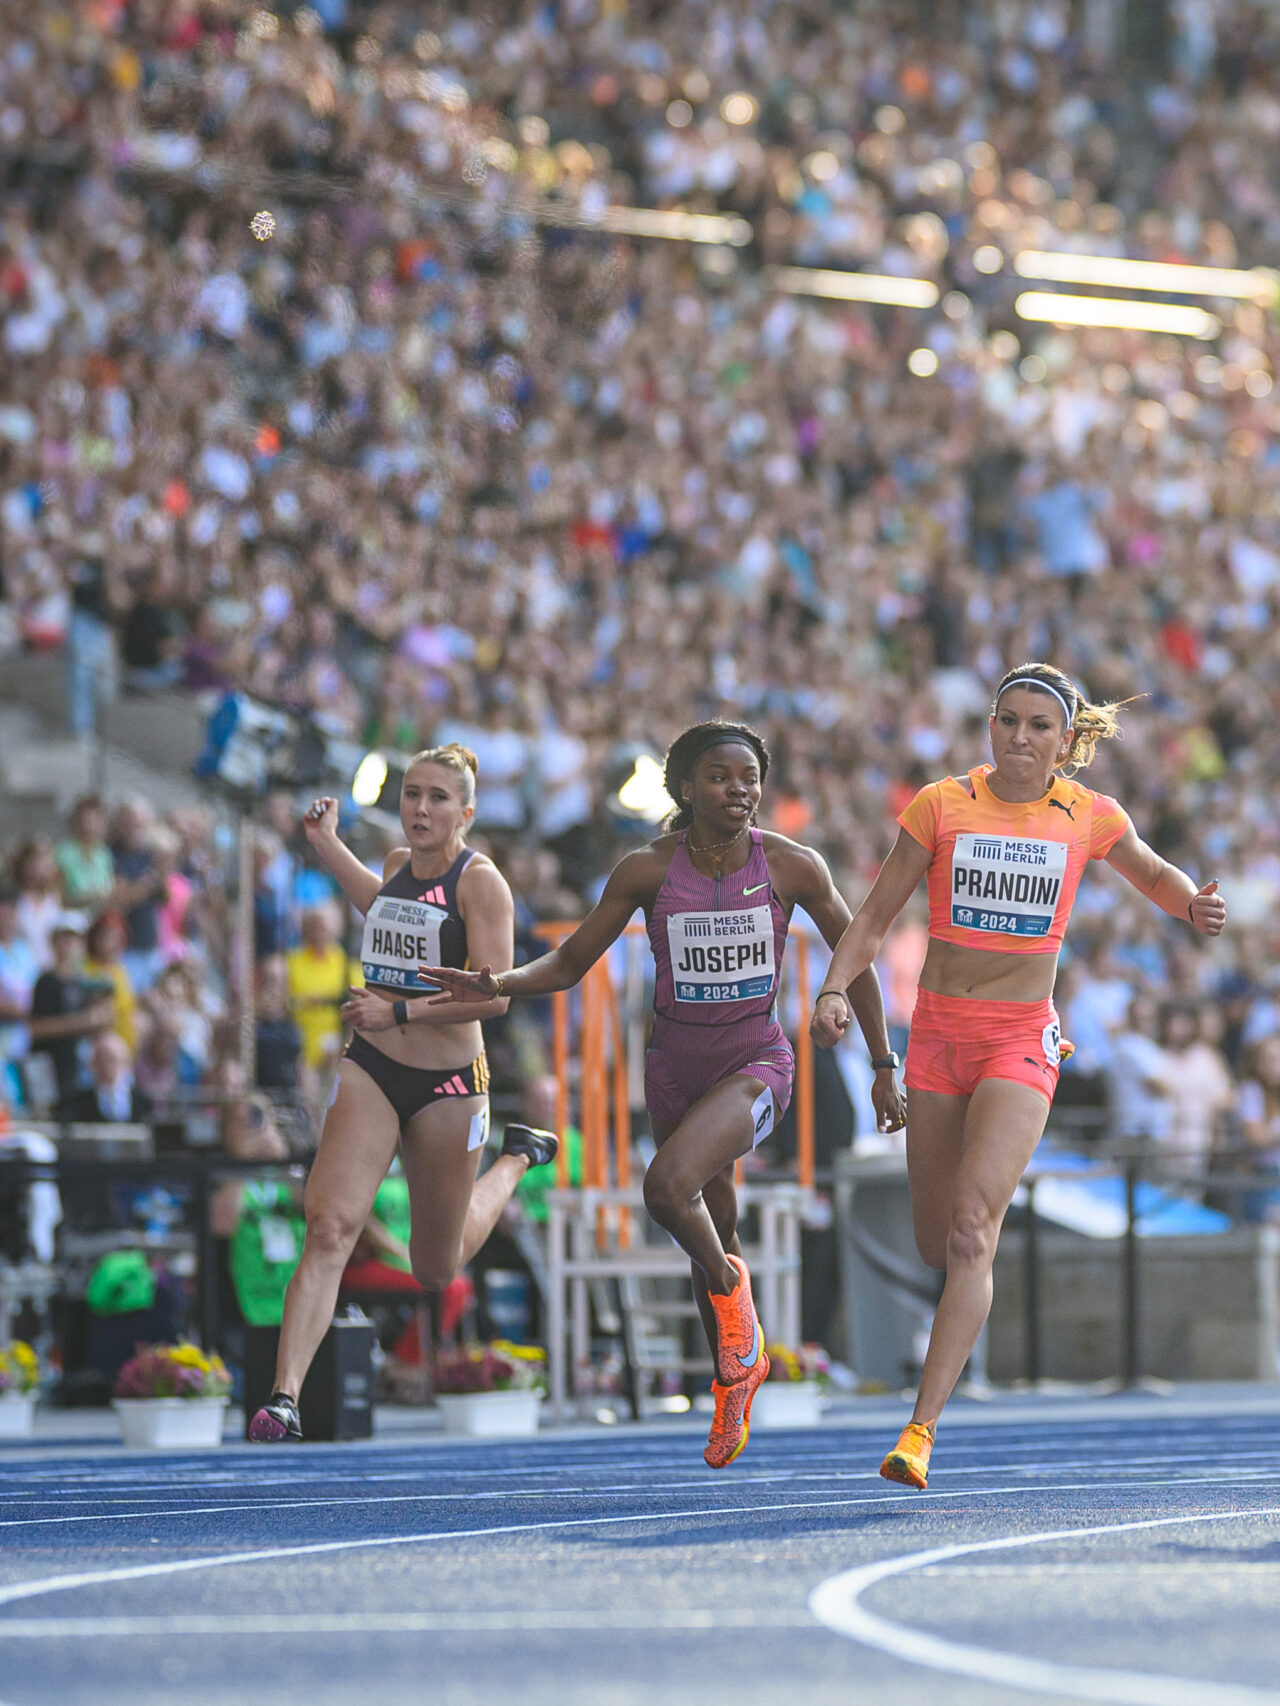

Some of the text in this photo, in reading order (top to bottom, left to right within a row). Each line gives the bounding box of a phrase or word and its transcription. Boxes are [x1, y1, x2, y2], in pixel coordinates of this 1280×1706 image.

[1005, 842, 1047, 855] MESSE
[1004, 852, 1047, 865] BERLIN
[954, 867, 1060, 906] PRANDINI
[402, 904, 429, 918] MESSE
[397, 914, 426, 927] BERLIN
[714, 914, 754, 926] MESSE
[979, 913, 1017, 931] 2024
[714, 924, 755, 936] BERLIN
[372, 928, 428, 960] HAASE
[678, 940, 766, 973] JOSEPH
[377, 968, 405, 985] 2024
[703, 984, 740, 999] 2024
